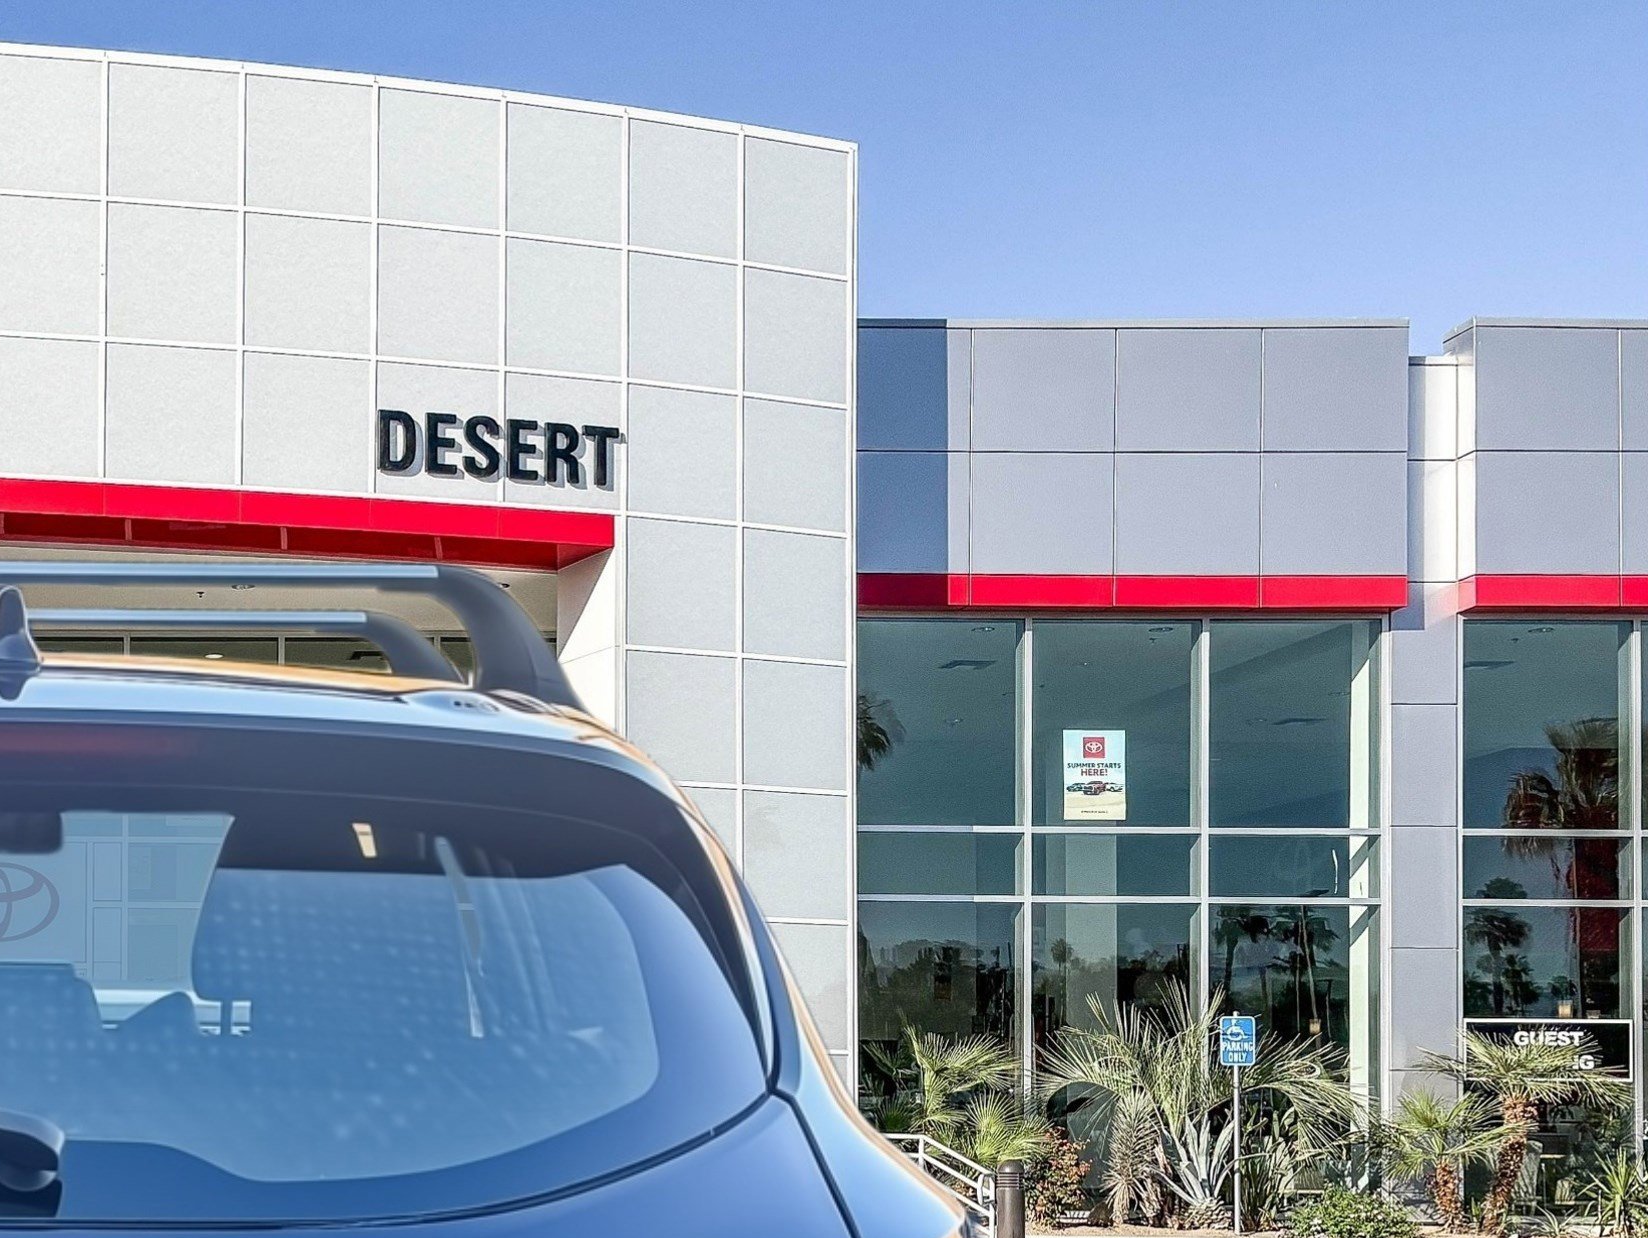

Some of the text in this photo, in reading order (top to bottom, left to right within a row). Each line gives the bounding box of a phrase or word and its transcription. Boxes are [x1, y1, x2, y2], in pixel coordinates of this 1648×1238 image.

[377, 409, 620, 487] DESERT
[1080, 769, 1108, 777] HERE!
[1514, 1031, 1584, 1047] GUEST
[1222, 1041, 1253, 1052] PARKING
[1228, 1052, 1248, 1062] ONLY
